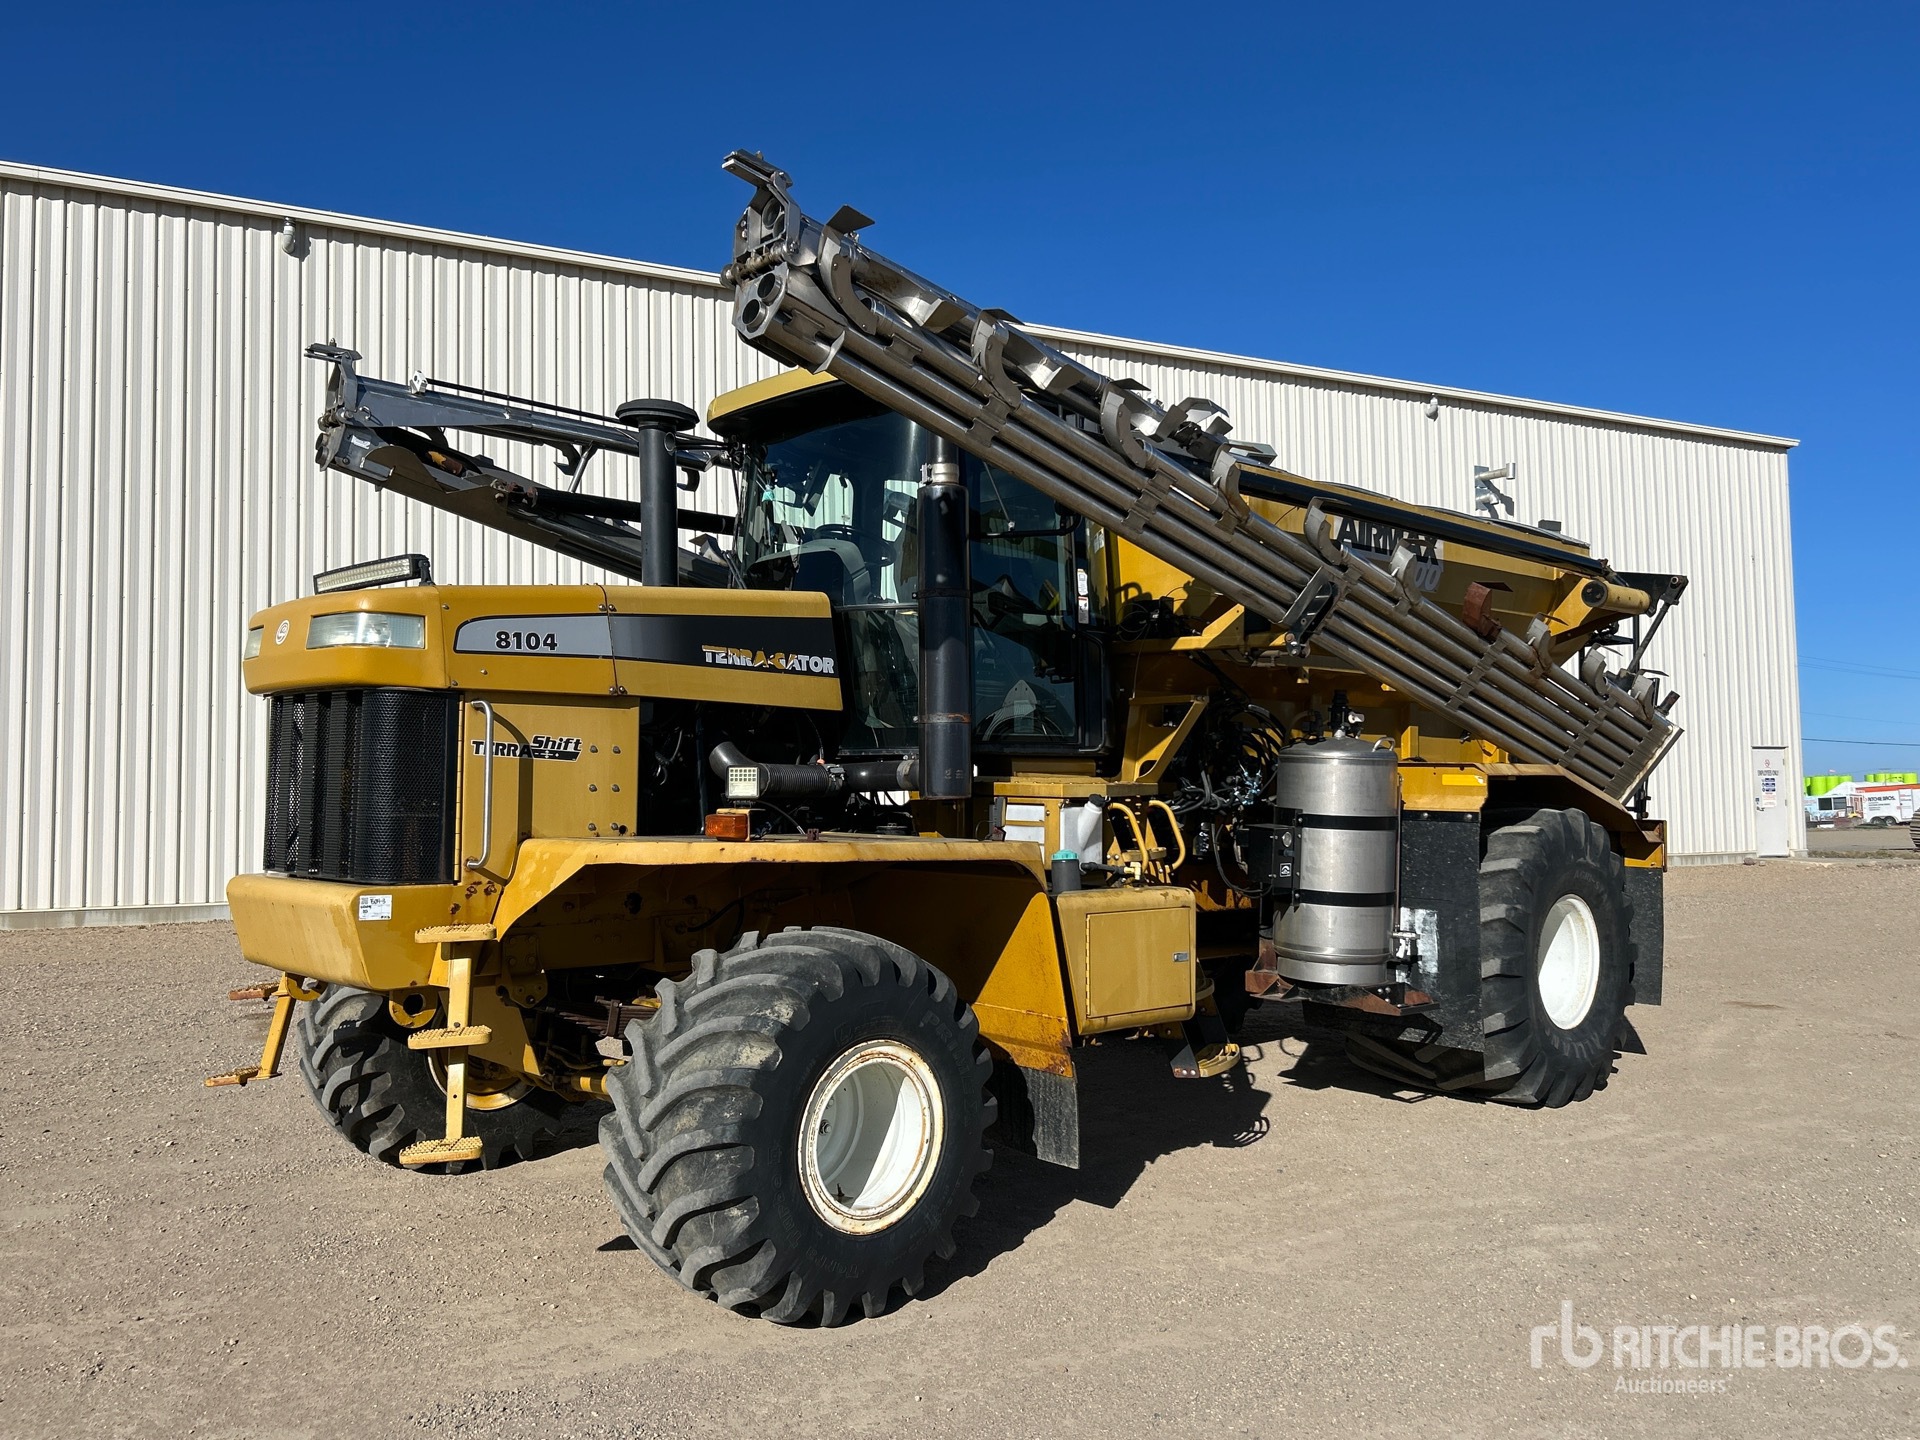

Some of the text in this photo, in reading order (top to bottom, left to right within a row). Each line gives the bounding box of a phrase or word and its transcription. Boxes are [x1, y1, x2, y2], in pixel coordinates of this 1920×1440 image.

[495, 630, 558, 651] 8104
[472, 735, 582, 759] TRRA Shift
